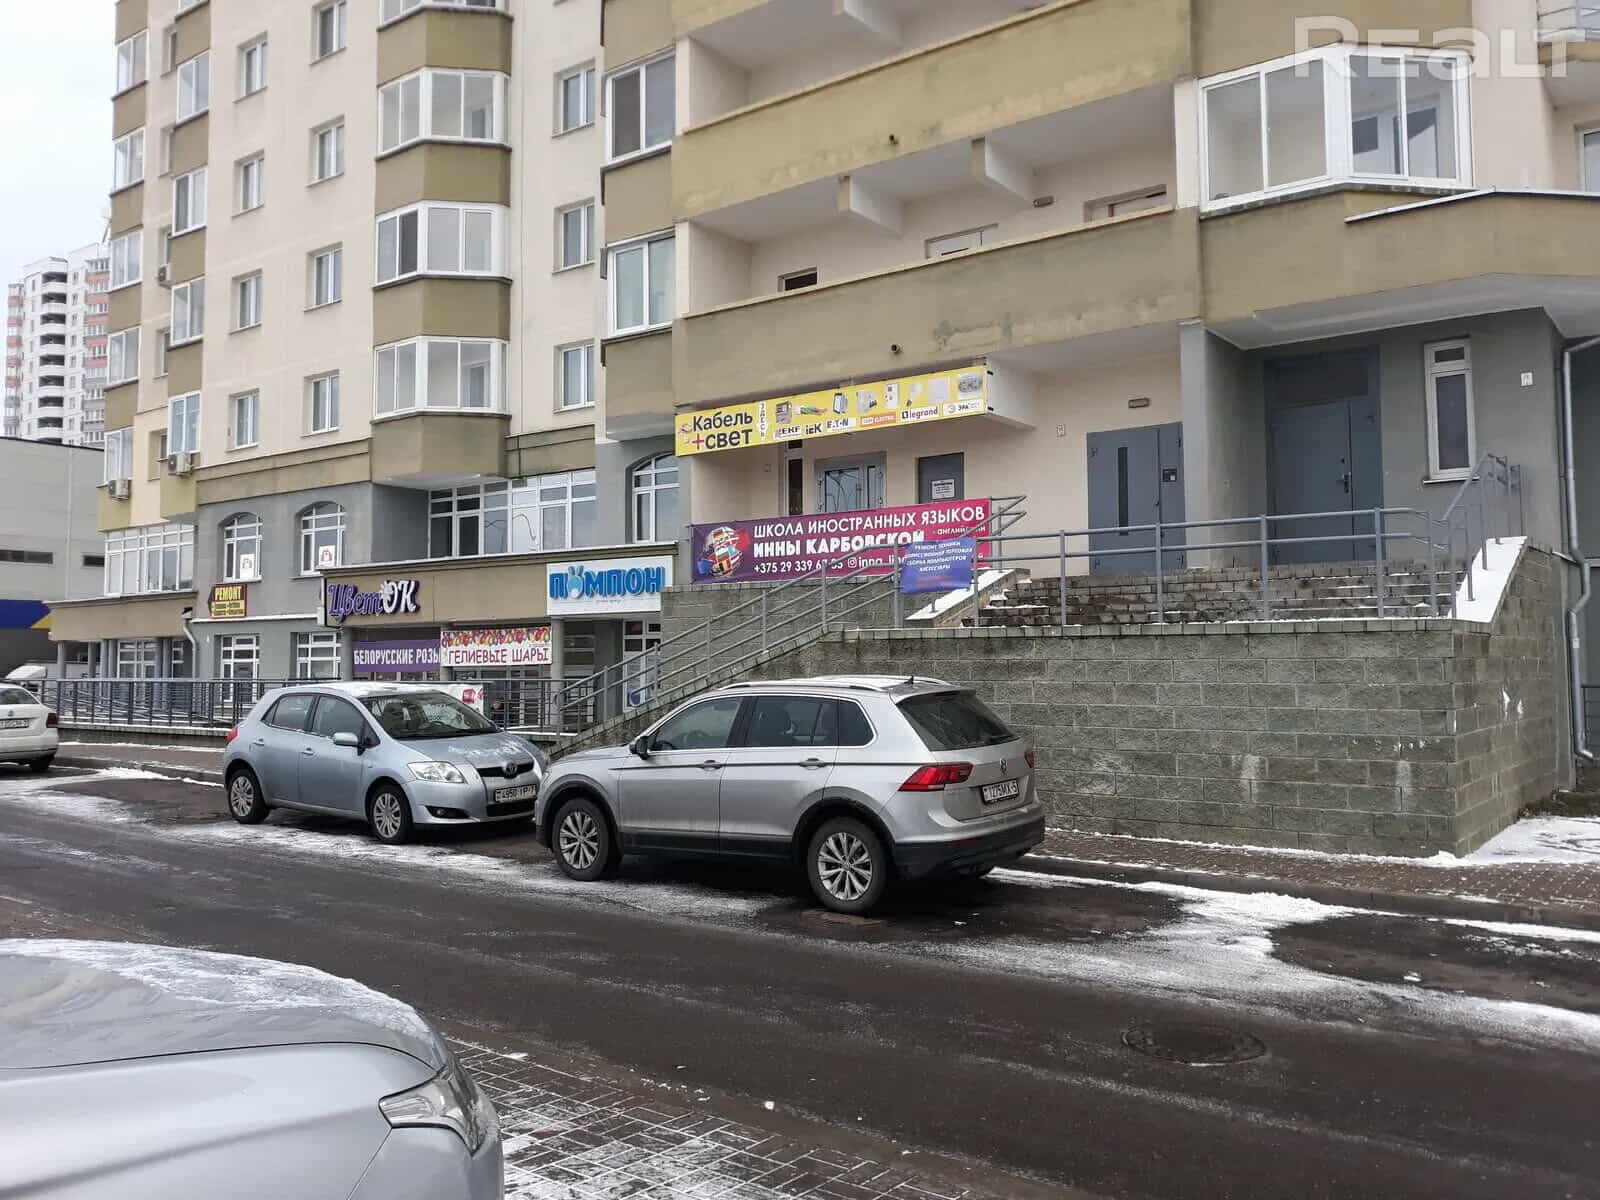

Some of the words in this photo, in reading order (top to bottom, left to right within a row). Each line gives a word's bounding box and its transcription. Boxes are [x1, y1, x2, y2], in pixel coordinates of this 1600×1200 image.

[693, 411, 753, 432] Кабель
[754, 522, 804, 538] ШКОЛА
[808, 512, 917, 534] ИНОСТРАННЫХ
[921, 506, 985, 525] ЯЗЫКОВ
[753, 540, 801, 558] ИННЫ
[754, 562, 778, 573] +375
[780, 561, 792, 572] 29
[794, 560, 813, 572] 339
[549, 567, 666, 599] ПОМПОН
[214, 586, 242, 601] РЕМОНТ
[353, 648, 414, 665] БЕЛОРУССКИЕ
[448, 648, 507, 665] ГЕЛИЕВЫЕ
[511, 647, 549, 663] ШАРЫ
